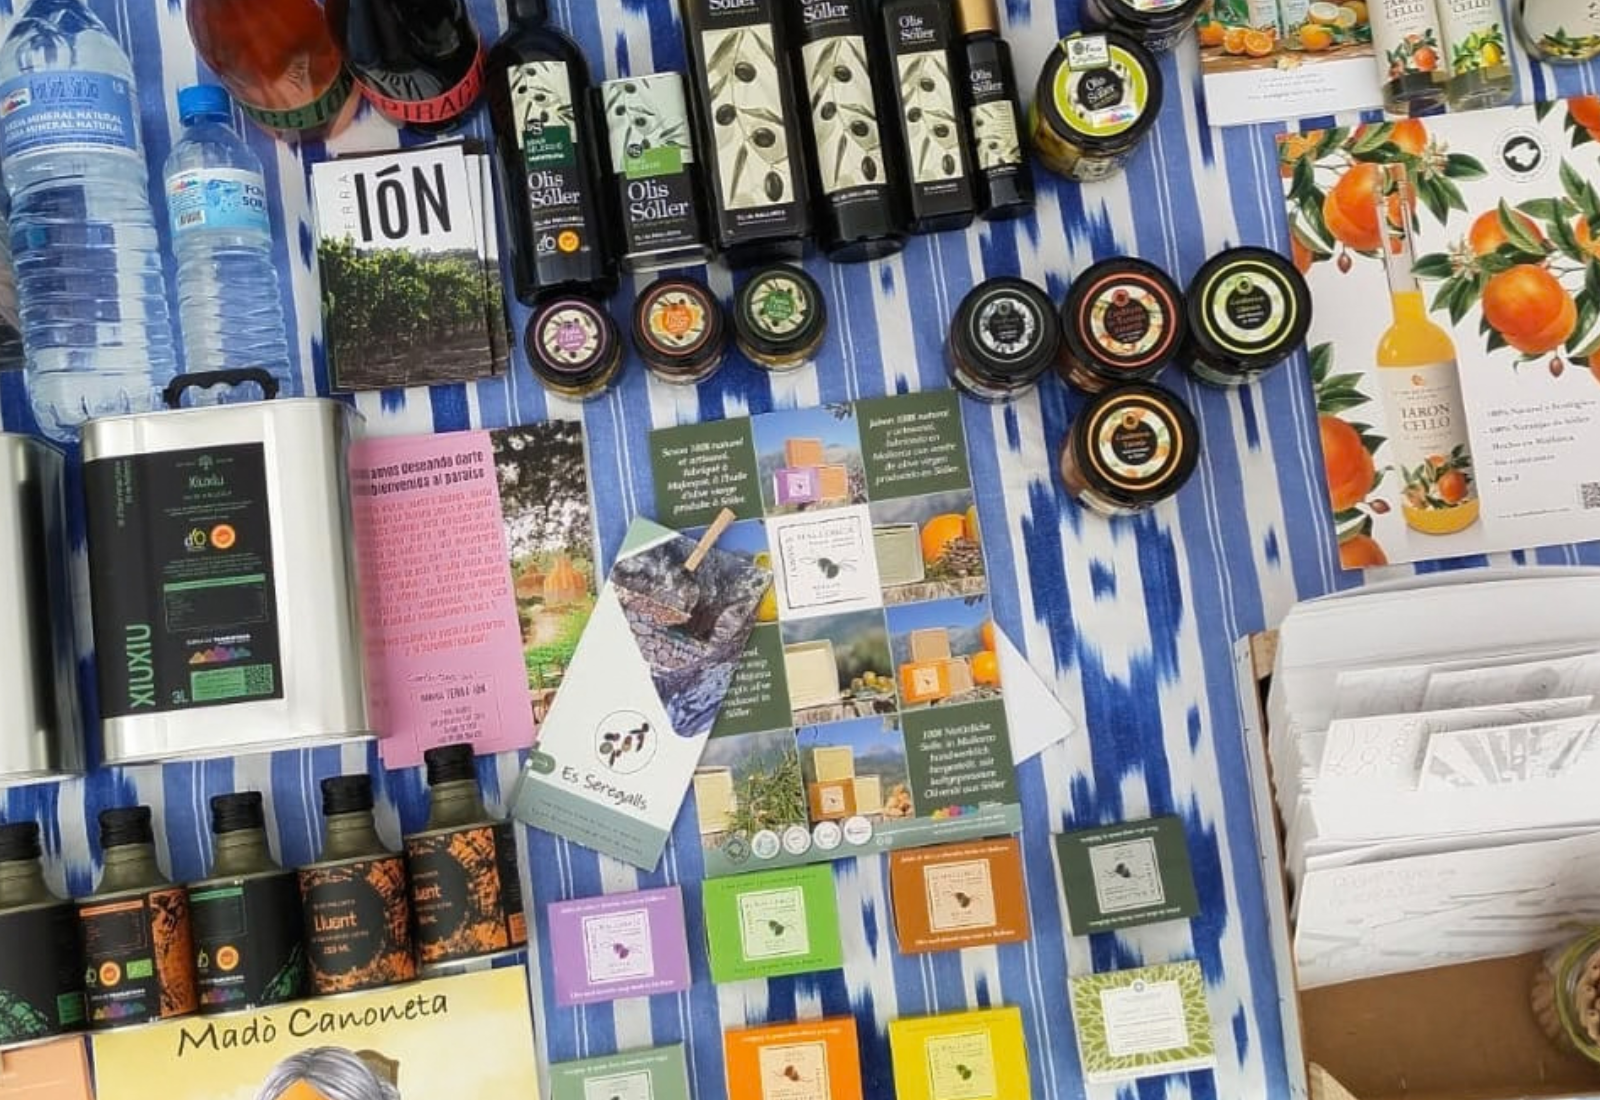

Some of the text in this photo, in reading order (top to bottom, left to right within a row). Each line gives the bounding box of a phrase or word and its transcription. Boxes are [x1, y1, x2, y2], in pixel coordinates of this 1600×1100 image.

[802, 2, 849, 23] Sóller
[26, 121, 73, 133] MINERAL
[27, 111, 73, 124] MINERAL
[76, 111, 123, 125] NATURAL
[528, 171, 563, 190] Olis
[628, 179, 669, 201] Olis
[530, 188, 580, 209] Sóller
[630, 200, 689, 222] Sóller
[402, 456, 454, 475] deseando
[455, 450, 484, 466] darte
[371, 477, 430, 497] bienvenida
[433, 474, 443, 487] al
[124, 623, 156, 709] XIUXIU
[561, 766, 649, 811] Es Seregalls
[177, 993, 448, 1058] Madò Canoneta
